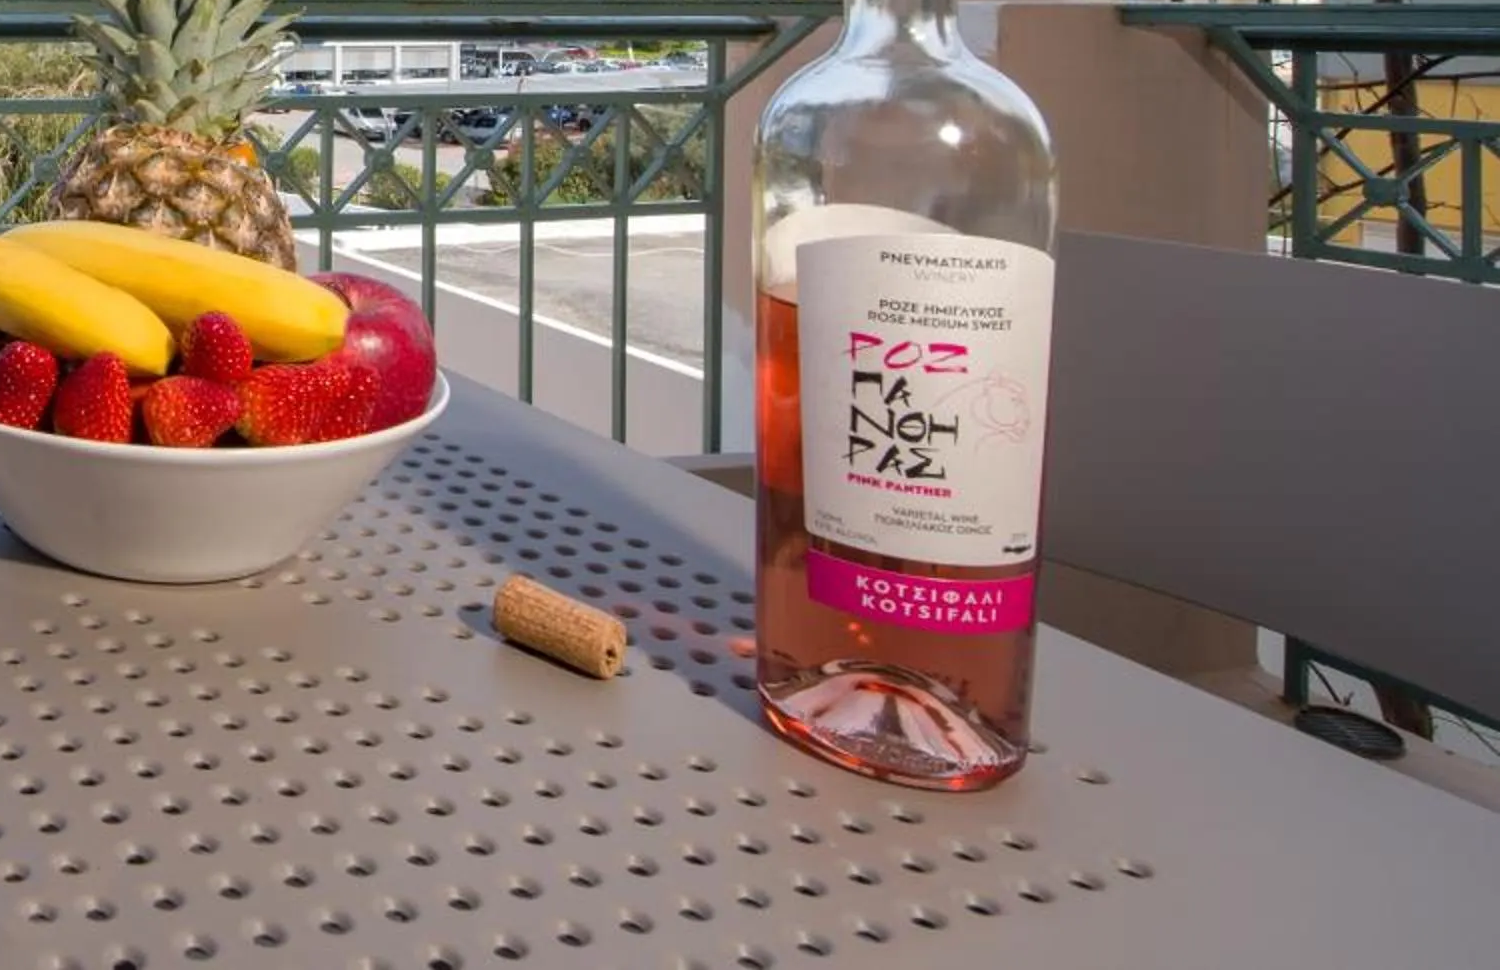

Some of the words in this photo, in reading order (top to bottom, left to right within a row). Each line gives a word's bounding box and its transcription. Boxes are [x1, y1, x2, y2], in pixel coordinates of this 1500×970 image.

[880, 251, 1007, 270] PNEVMATIKAKIS
[867, 310, 906, 325] ROSE
[910, 316, 969, 330] MEDIUM
[970, 319, 1012, 331] SWEET
[847, 472, 881, 489] PINK
[885, 481, 953, 498] PANTHER
[891, 506, 946, 522] VARIETAL
[950, 513, 978, 524] WINE
[861, 593, 997, 623] KOTSIFALI
